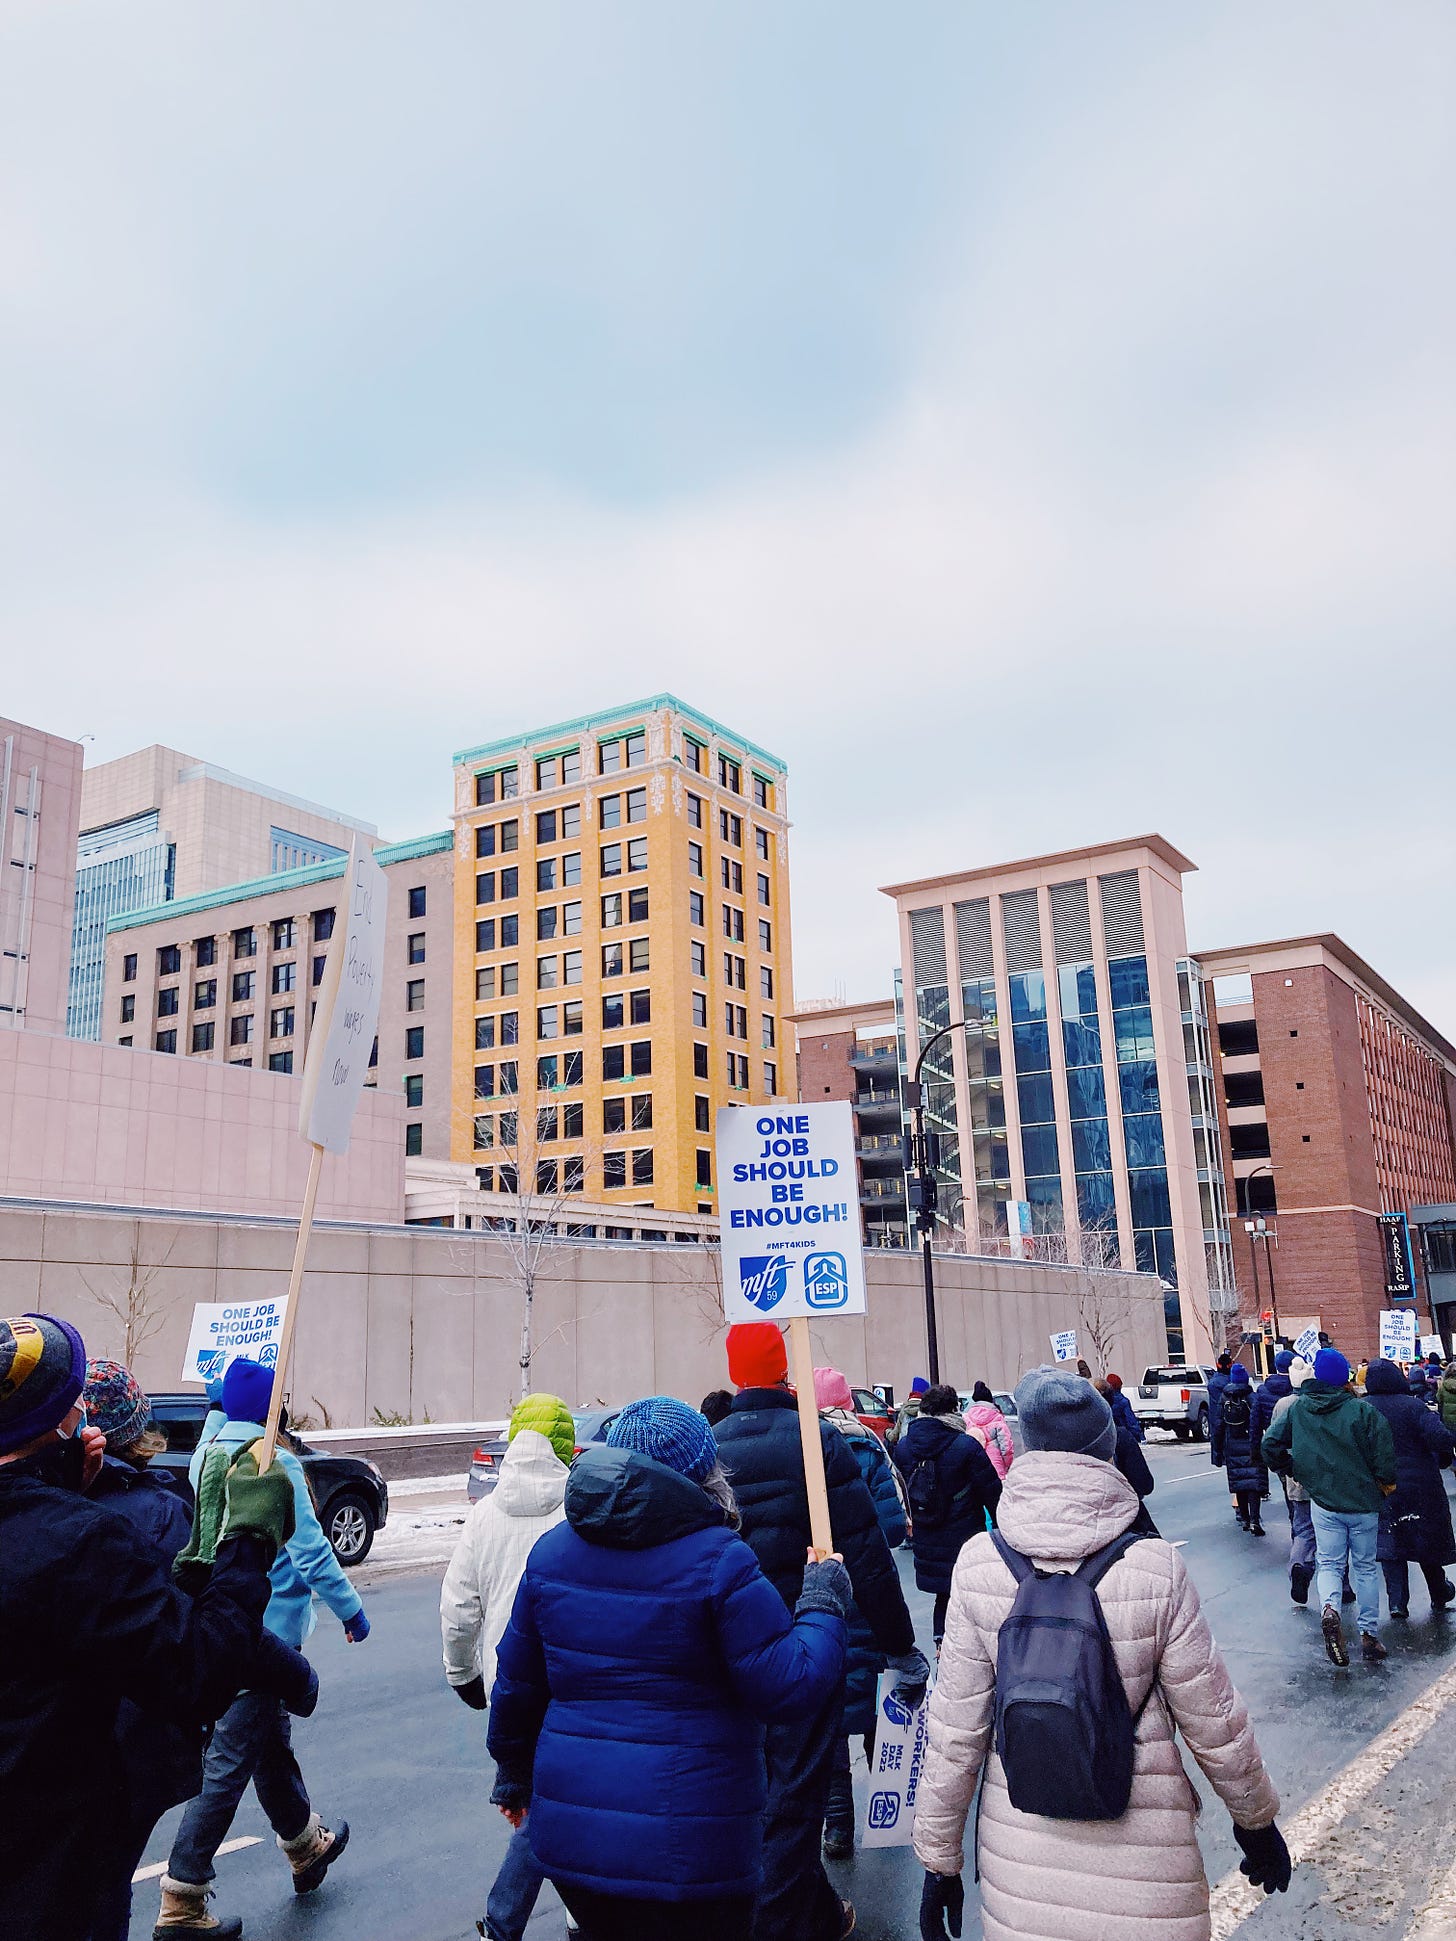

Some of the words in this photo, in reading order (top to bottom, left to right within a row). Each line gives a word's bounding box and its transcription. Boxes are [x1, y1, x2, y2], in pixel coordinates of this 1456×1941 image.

[756, 1115, 810, 1136] ONE
[760, 1138, 809, 1158] JOB
[733, 1158, 839, 1183] SHOULD
[771, 1183, 804, 1204] BE
[730, 1203, 848, 1229] ENOUGH!
[766, 1240, 816, 1250] #MFT4KIDS
[1391, 1227, 1405, 1282] PARKING
[741, 1255, 796, 1303] mft
[815, 1282, 837, 1295] ESP
[766, 1290, 778, 1302] 59
[222, 1307, 251, 1320] ONE
[253, 1303, 275, 1317] JOB
[209, 1319, 263, 1333] SHOULD
[265, 1315, 280, 1328] BE
[216, 1330, 272, 1346] ENOUGH!
[879, 1742, 889, 1773] 2022
[888, 1745, 897, 1771] DAY
[895, 1744, 904, 1771] MLK
[905, 1709, 925, 1807] WORKERS!
[875, 1800, 884, 1820] ESP
